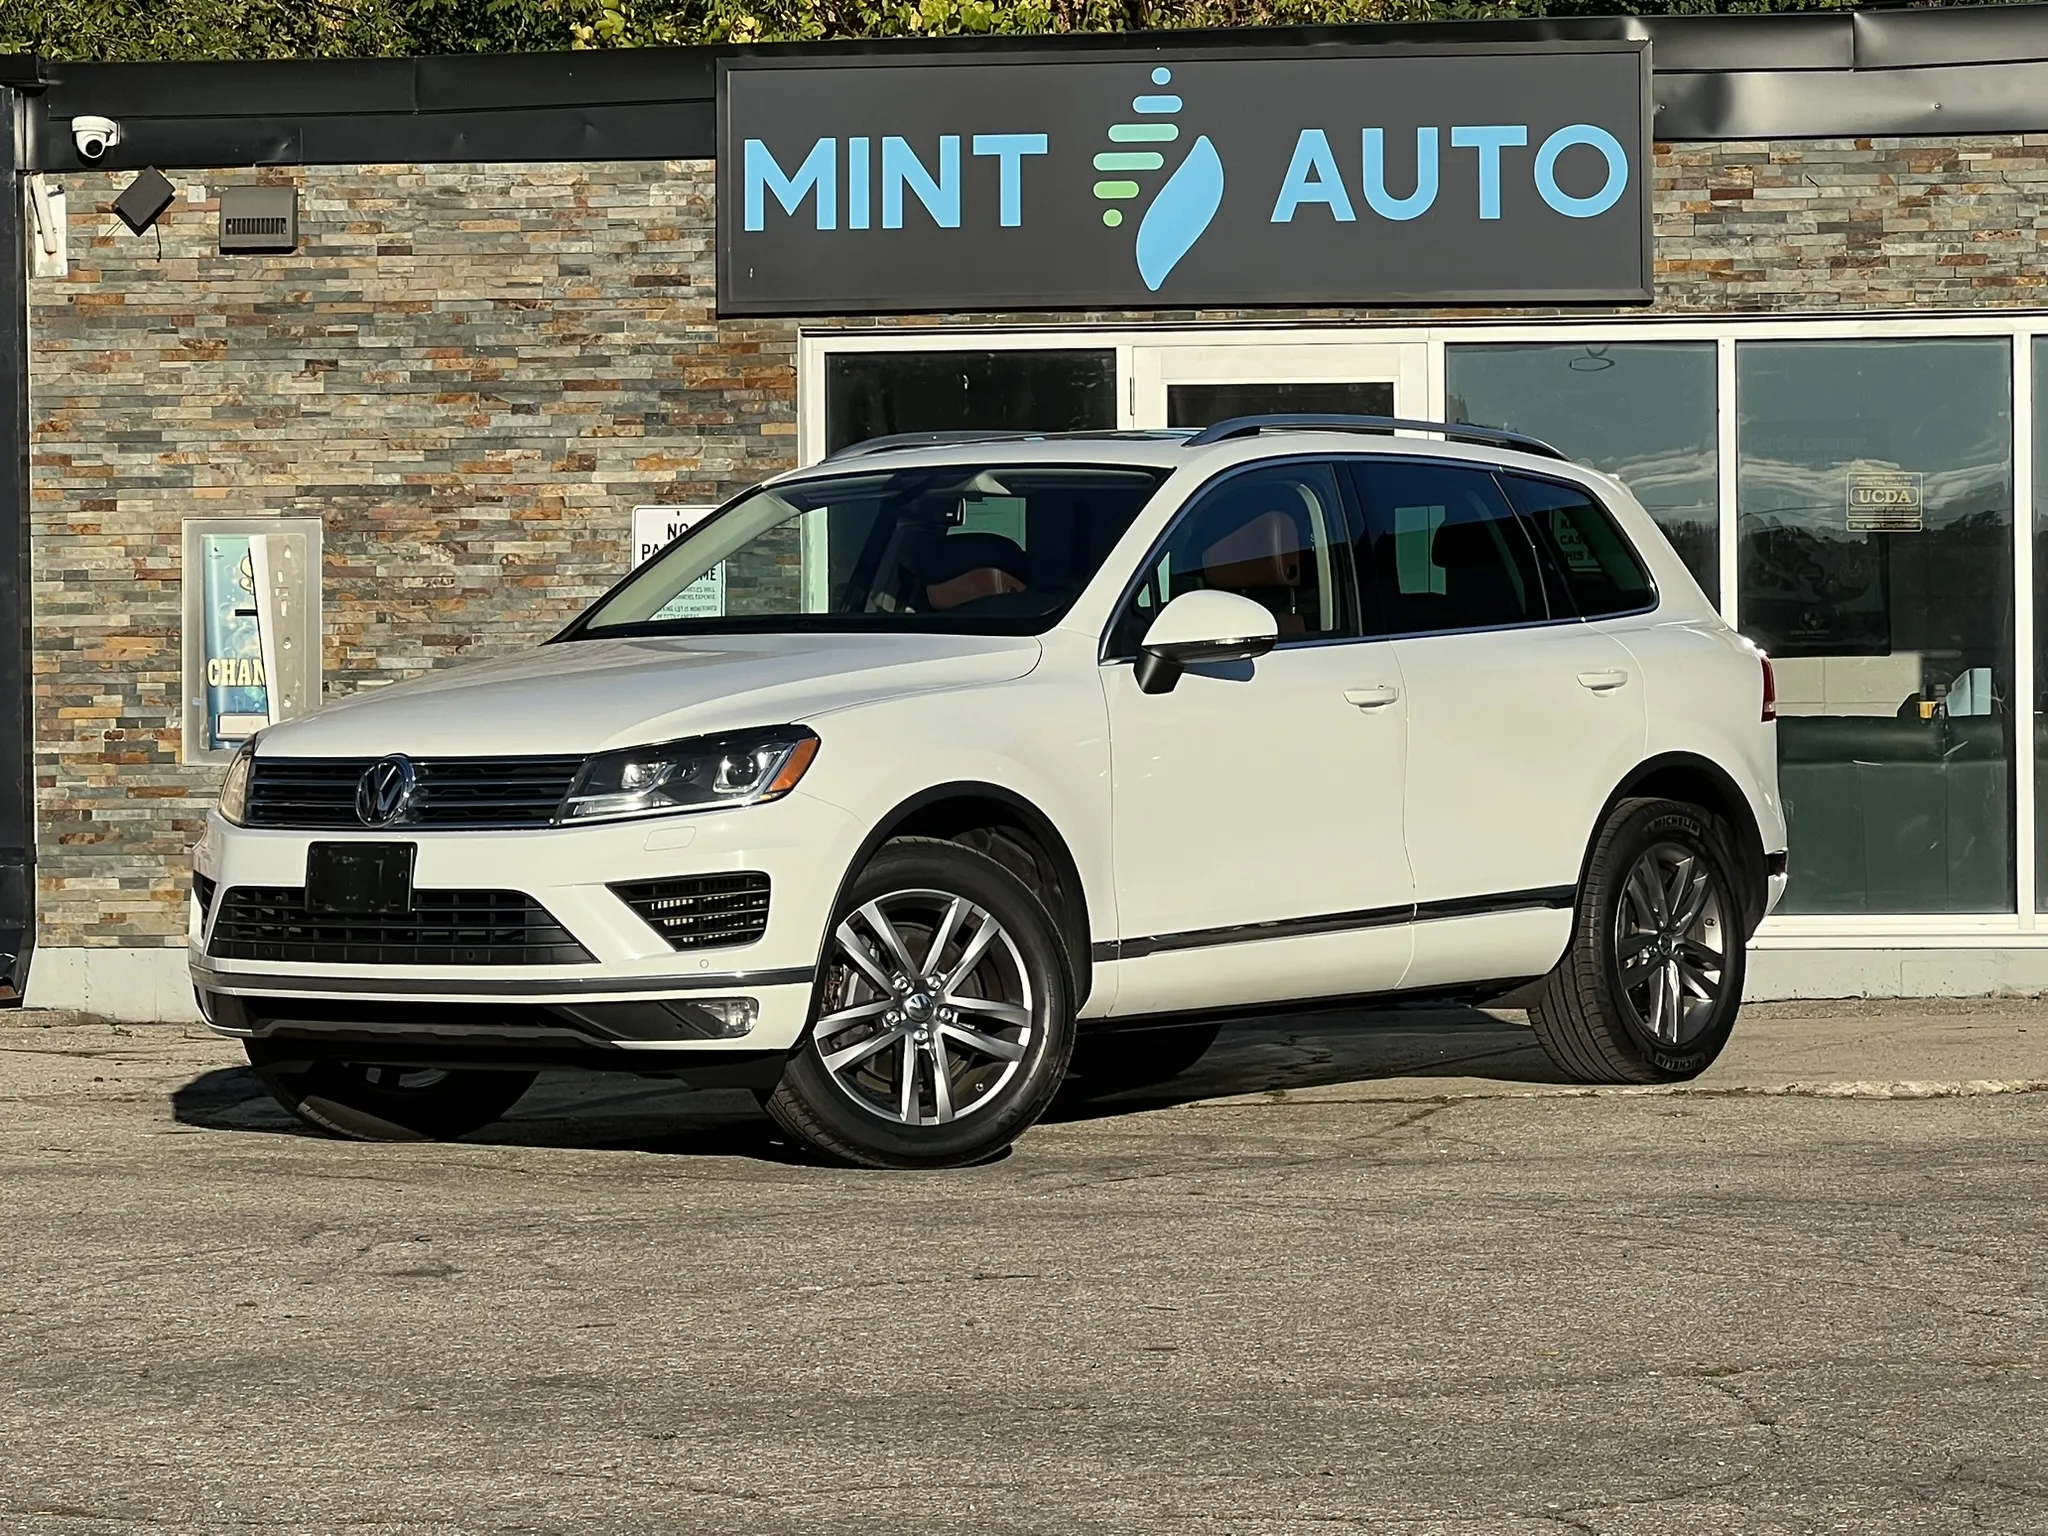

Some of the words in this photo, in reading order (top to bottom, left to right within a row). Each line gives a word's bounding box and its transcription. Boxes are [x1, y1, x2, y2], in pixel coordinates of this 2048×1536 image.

[744, 133, 1048, 232] MINT
[1270, 123, 1629, 222] AUTO
[1858, 489, 1912, 503] UCDA
[641, 543, 666, 560] PA
[1654, 815, 1699, 832] MICHELIN
